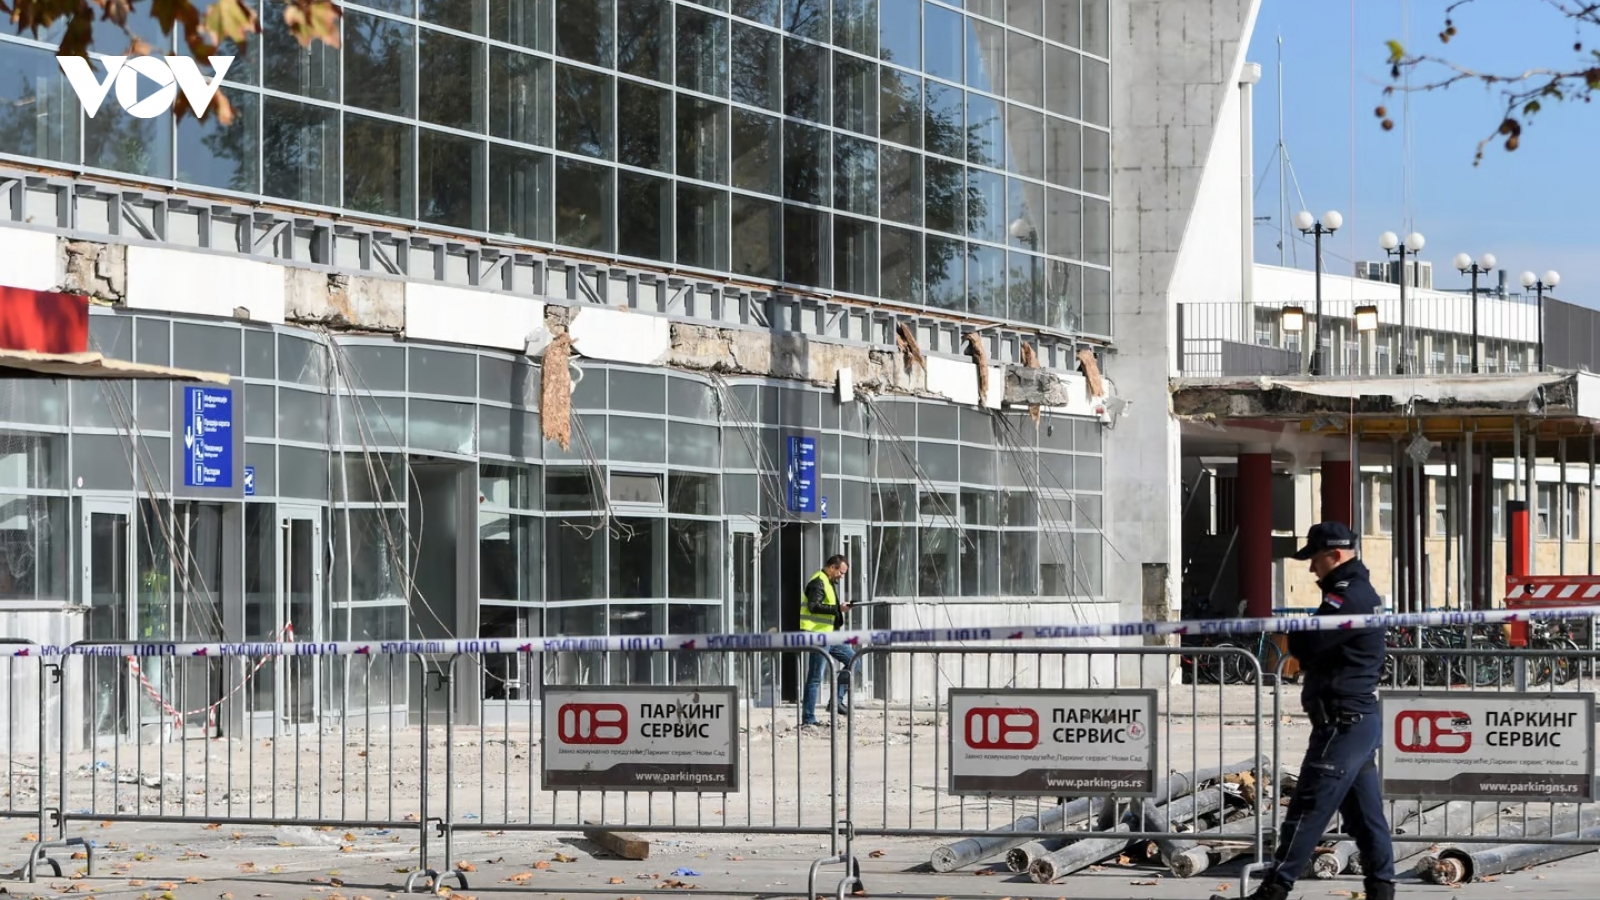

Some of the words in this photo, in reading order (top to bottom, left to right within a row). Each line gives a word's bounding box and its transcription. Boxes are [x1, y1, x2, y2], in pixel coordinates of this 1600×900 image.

[641, 704, 725, 719] ПАРКИНГ
[1053, 709, 1142, 724] ПАРКИНГ
[1485, 712, 1578, 727] ПАРКИНГ
[641, 723, 709, 738] СЕРВИС
[1053, 728, 1125, 744] СЕРВИС
[1486, 731, 1561, 747] СЕРВИС
[696, 749, 713, 757] Нови
[714, 749, 726, 757] Сад
[1130, 755, 1143, 763] Сад
[635, 771, 726, 784] www.parkingns.rs
[1047, 777, 1143, 790] www.parkingns.rs
[1479, 781, 1579, 794] www.parkingns.rs
